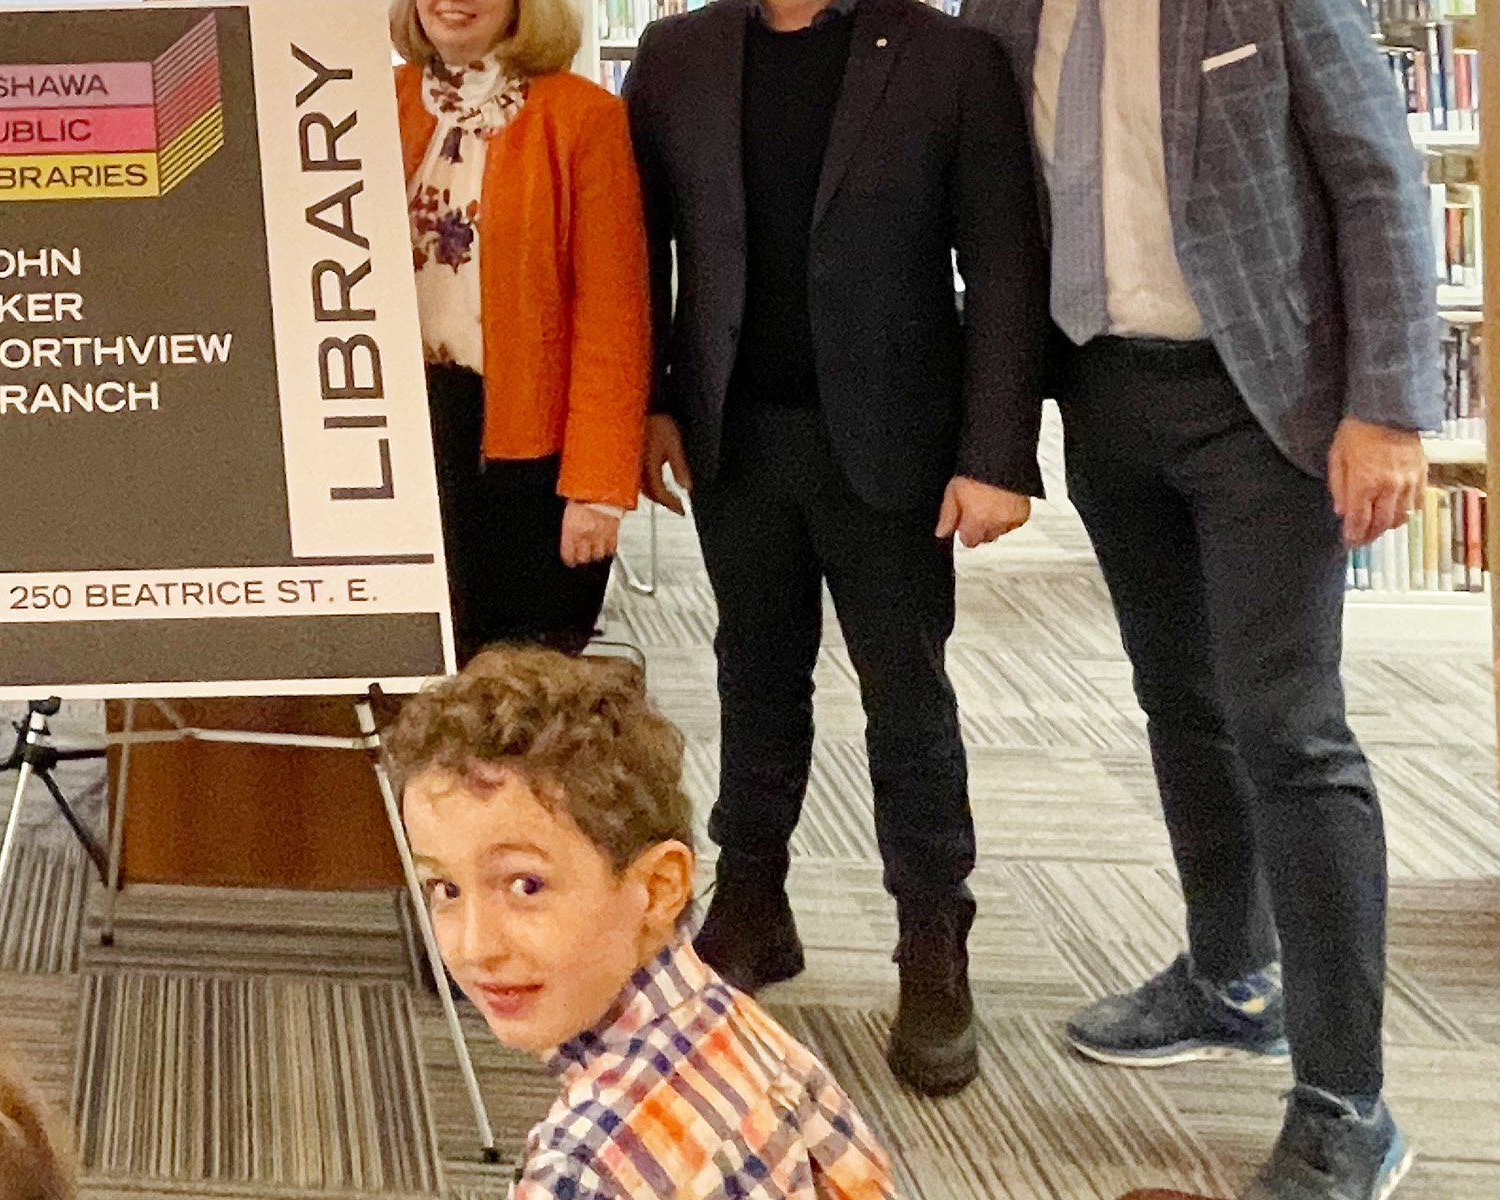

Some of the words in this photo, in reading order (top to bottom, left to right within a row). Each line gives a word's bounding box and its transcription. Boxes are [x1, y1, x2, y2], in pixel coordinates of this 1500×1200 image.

[290, 42, 395, 500] LIBRARY
[9, 584, 72, 610] 250
[85, 580, 266, 608] BEATRICE
[277, 578, 336, 604] ST.
[347, 578, 378, 602] E.
